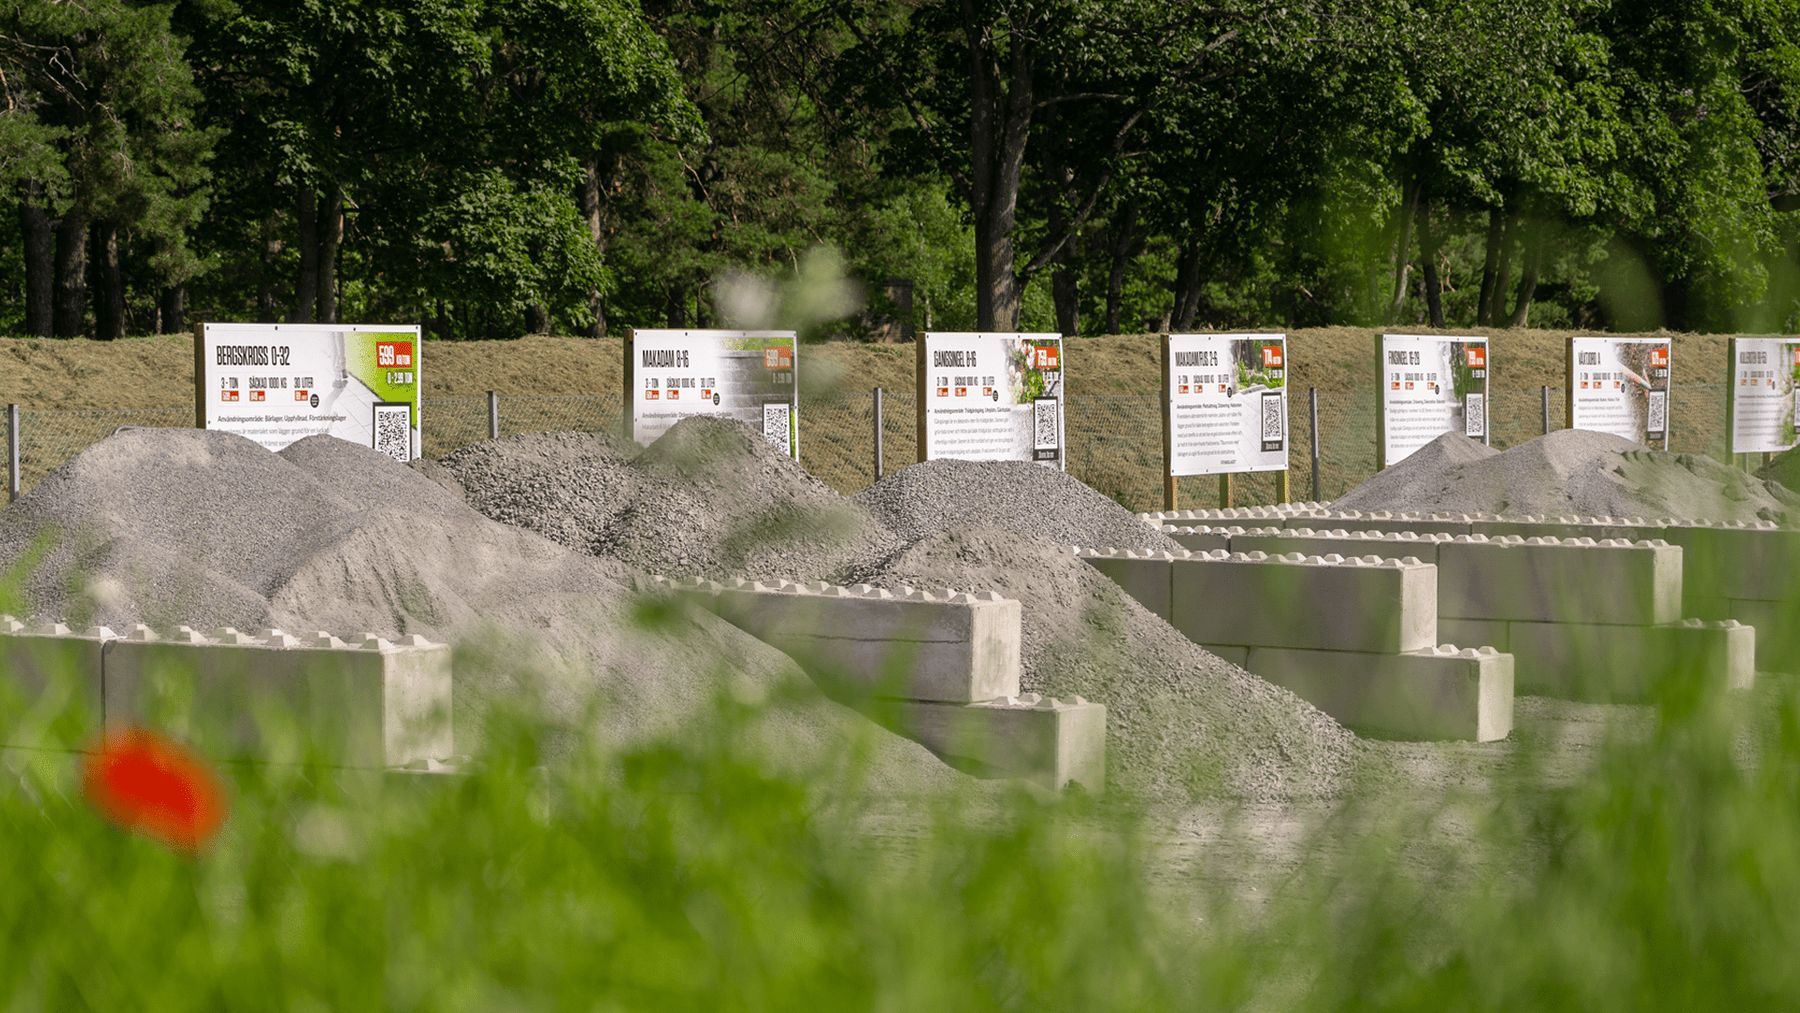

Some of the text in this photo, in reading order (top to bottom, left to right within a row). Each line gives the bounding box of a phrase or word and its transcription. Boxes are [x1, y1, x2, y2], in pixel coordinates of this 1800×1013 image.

[216, 345, 290, 366] BERGSKROSS 0-32
[378, 345, 394, 365] 599
[642, 349, 690, 368] MAKADAM 8-16
[229, 377, 239, 389] TON
